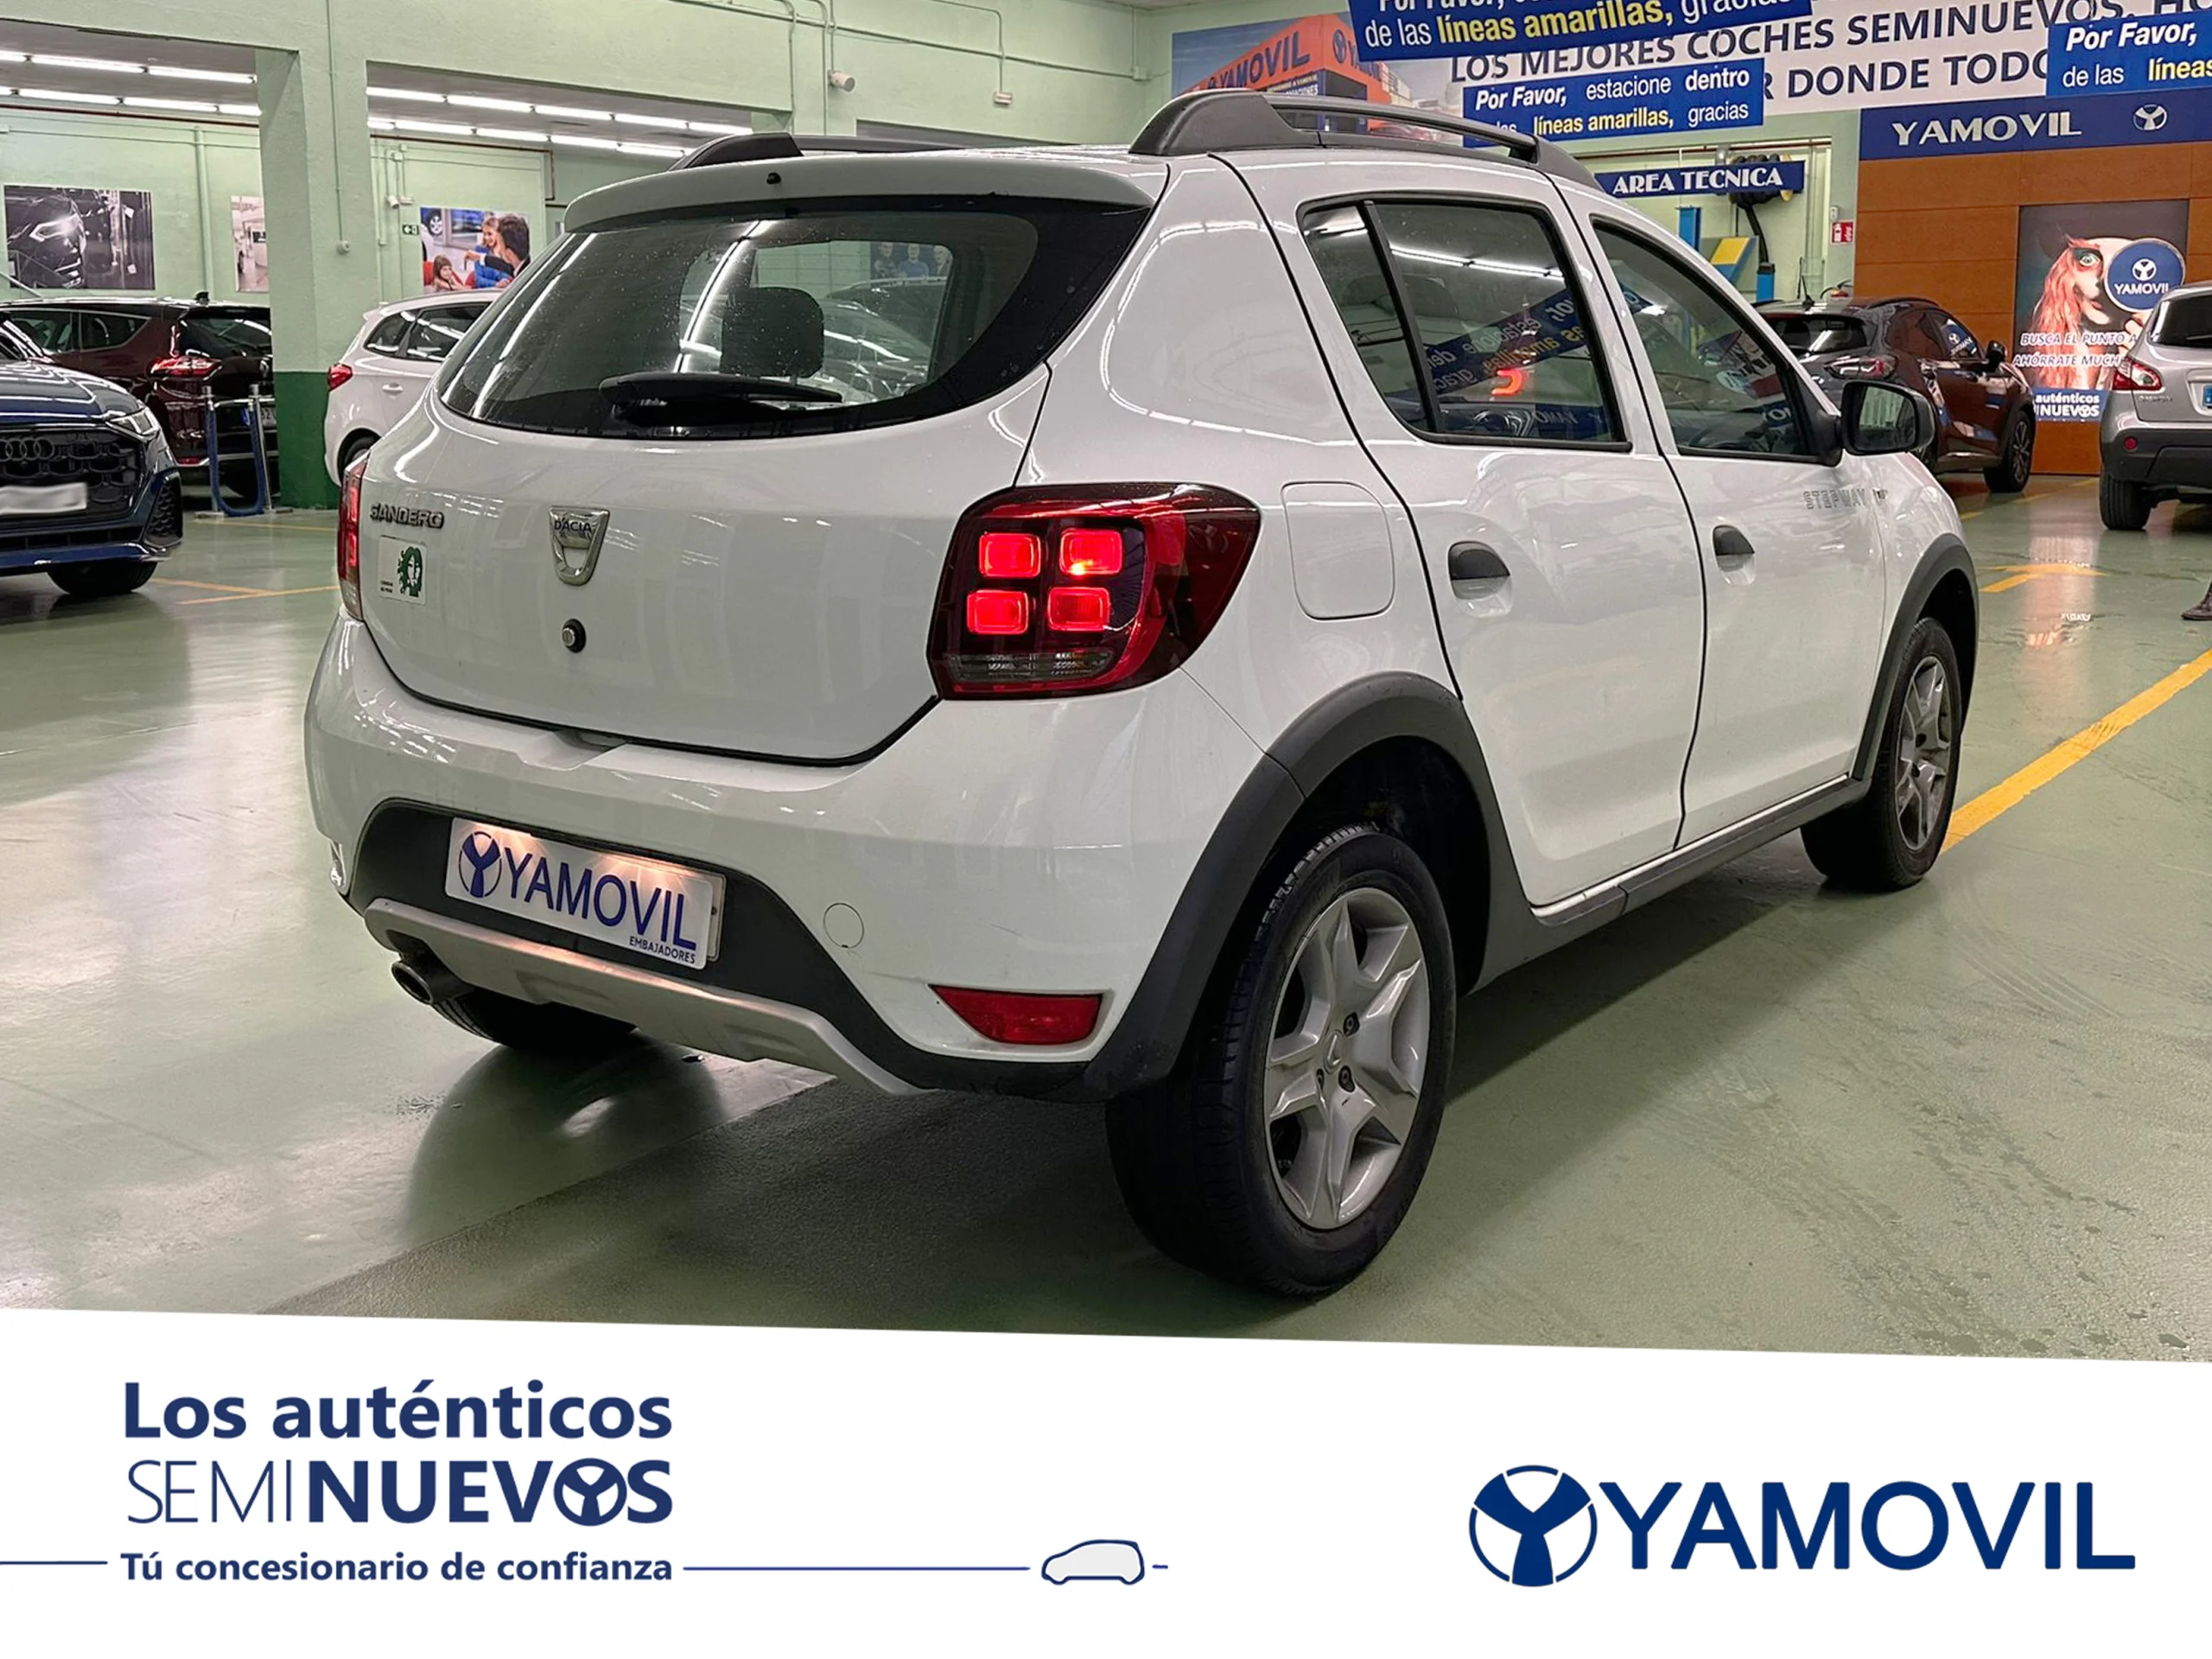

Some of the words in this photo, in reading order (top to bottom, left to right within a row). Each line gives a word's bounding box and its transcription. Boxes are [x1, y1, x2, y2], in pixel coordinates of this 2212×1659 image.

[1365, 20, 1392, 48] de
[1398, 18, 1432, 46] las
[1436, 15, 1516, 43] líneas
[1523, 0, 1674, 39] amarillas,
[2065, 28, 2113, 52] Por
[2118, 22, 2197, 47] Favor,
[1451, 54, 1509, 82] LOS
[1521, 36, 1675, 76] MEJORES
[1688, 18, 1834, 60] COCHES
[1476, 88, 1507, 111] Por
[1511, 85, 1567, 108] Favor,
[1586, 75, 1672, 101] estacione
[1685, 67, 1750, 92] dentro
[1788, 59, 1929, 99] DONDE
[2063, 66, 2089, 88] de
[2094, 64, 2125, 86] las
[1534, 116, 1584, 136] líneas
[1587, 106, 1675, 132] amarillas,
[1688, 100, 1749, 128] gracias
[1891, 111, 2082, 147] YAMOVIL
[1611, 173, 1675, 195] AREA
[1680, 168, 1783, 190] TECNICA
[2020, 333, 2062, 345] BUSCA
[2082, 333, 2126, 344] PUNTO
[2035, 392, 2101, 404] auténticos
[370, 503, 444, 529] SANDERO
[553, 518, 593, 533] DACIA
[504, 846, 697, 950] YAMOVIL
[629, 935, 696, 964] EMBAJADORES
